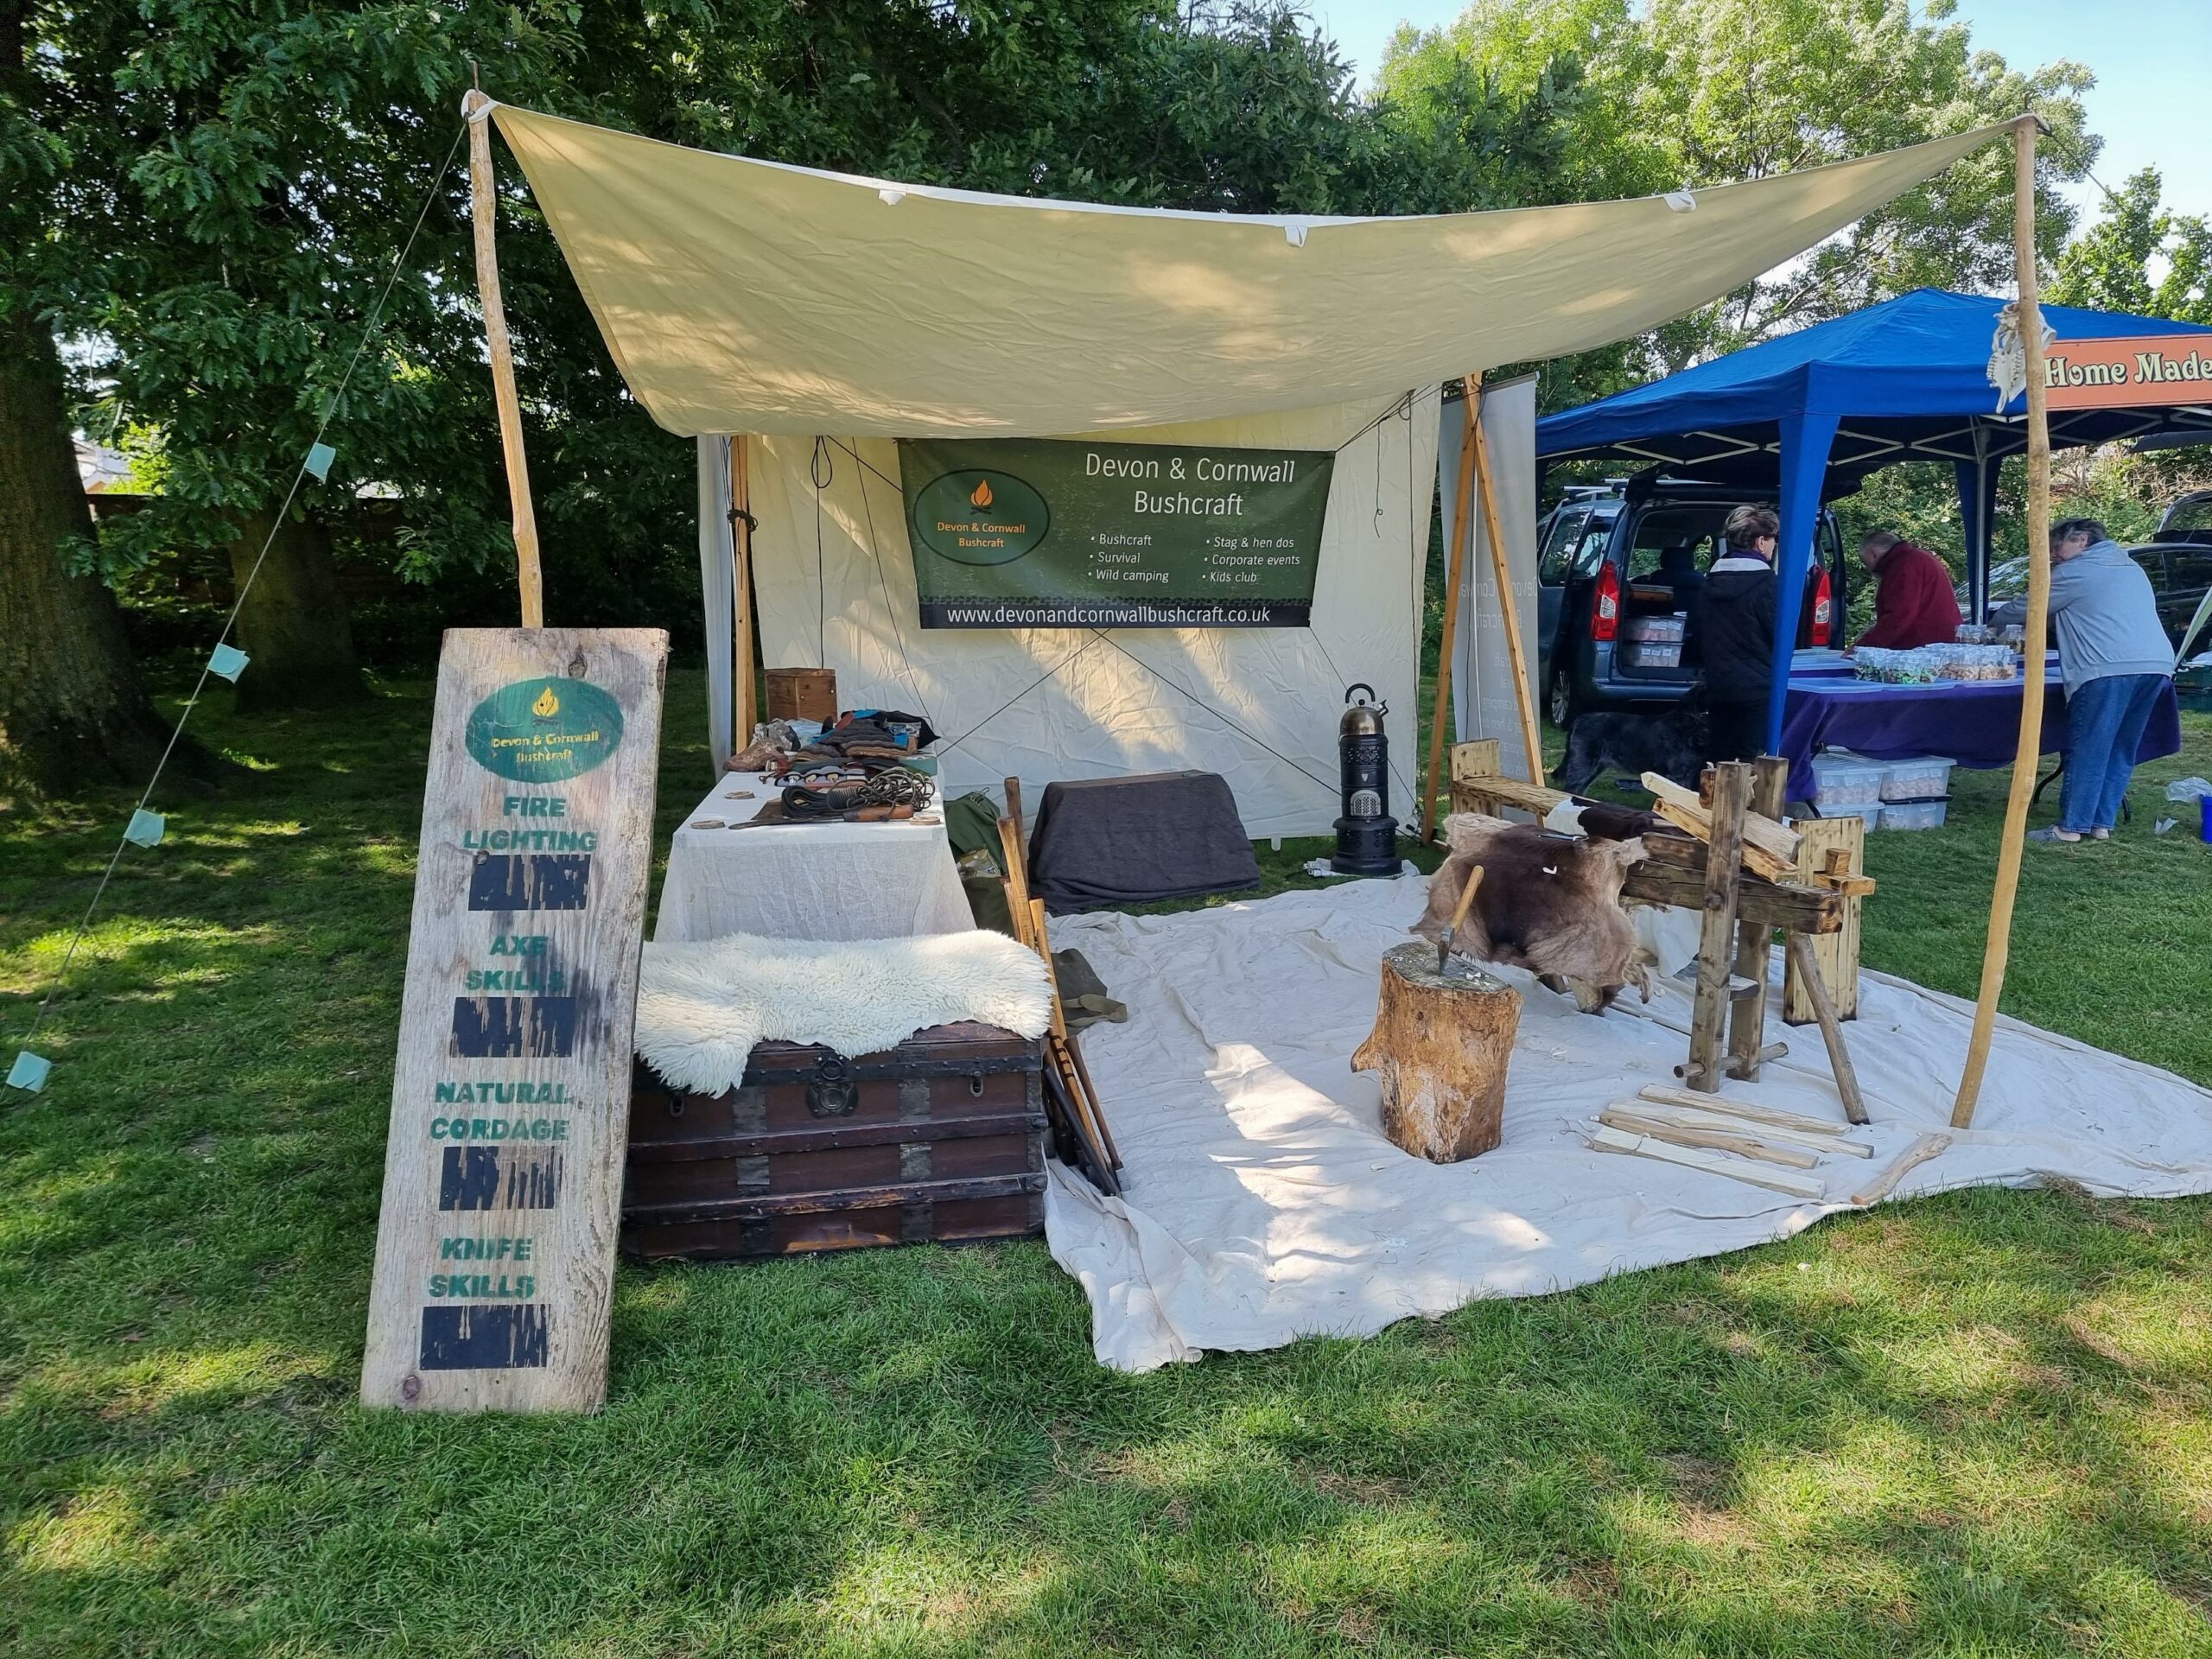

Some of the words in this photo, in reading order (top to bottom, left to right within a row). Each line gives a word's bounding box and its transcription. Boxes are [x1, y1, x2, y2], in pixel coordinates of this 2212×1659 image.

[2044, 356, 2127, 387] Home
[2133, 350, 2212, 384] Made
[1085, 453, 1159, 479] Devon
[1170, 458, 1185, 480] &
[1196, 458, 1295, 483] Cornwall
[1134, 490, 1243, 516] Bushcraft
[938, 521, 969, 533] Devon
[971, 522, 980, 533] &
[982, 521, 1026, 534] Cornwall
[958, 537, 1005, 549] Bushcraft
[1099, 533, 1152, 547] Bushcraft
[1213, 535, 1237, 550] Stag
[1241, 537, 1249, 549] &
[1253, 537, 1273, 548] hen
[1275, 537, 1294, 549] dos
[1097, 550, 1141, 564] Survival
[1211, 554, 1264, 569] Corporate
[1267, 555, 1300, 567] events
[1096, 569, 1119, 582] Wild
[1122, 570, 1169, 584] camping
[1210, 570, 1231, 583] Kids
[1235, 570, 1257, 583] club
[947, 607, 1270, 625] www.devonandcornwallbushcraft.co.uk
[492, 736, 530, 748] Devon
[532, 734, 543, 745] &
[545, 731, 599, 744] Cornwall
[502, 796, 567, 817] FIRE
[463, 830, 598, 852] LIGHTING
[489, 935, 549, 957] AXE
[464, 969, 565, 992] SKILLS
[435, 1081, 574, 1105] NATURAL
[429, 1117, 570, 1141] CORDAGE
[441, 1236, 533, 1262] KNIFE
[428, 1274, 535, 1299] SKILLS
